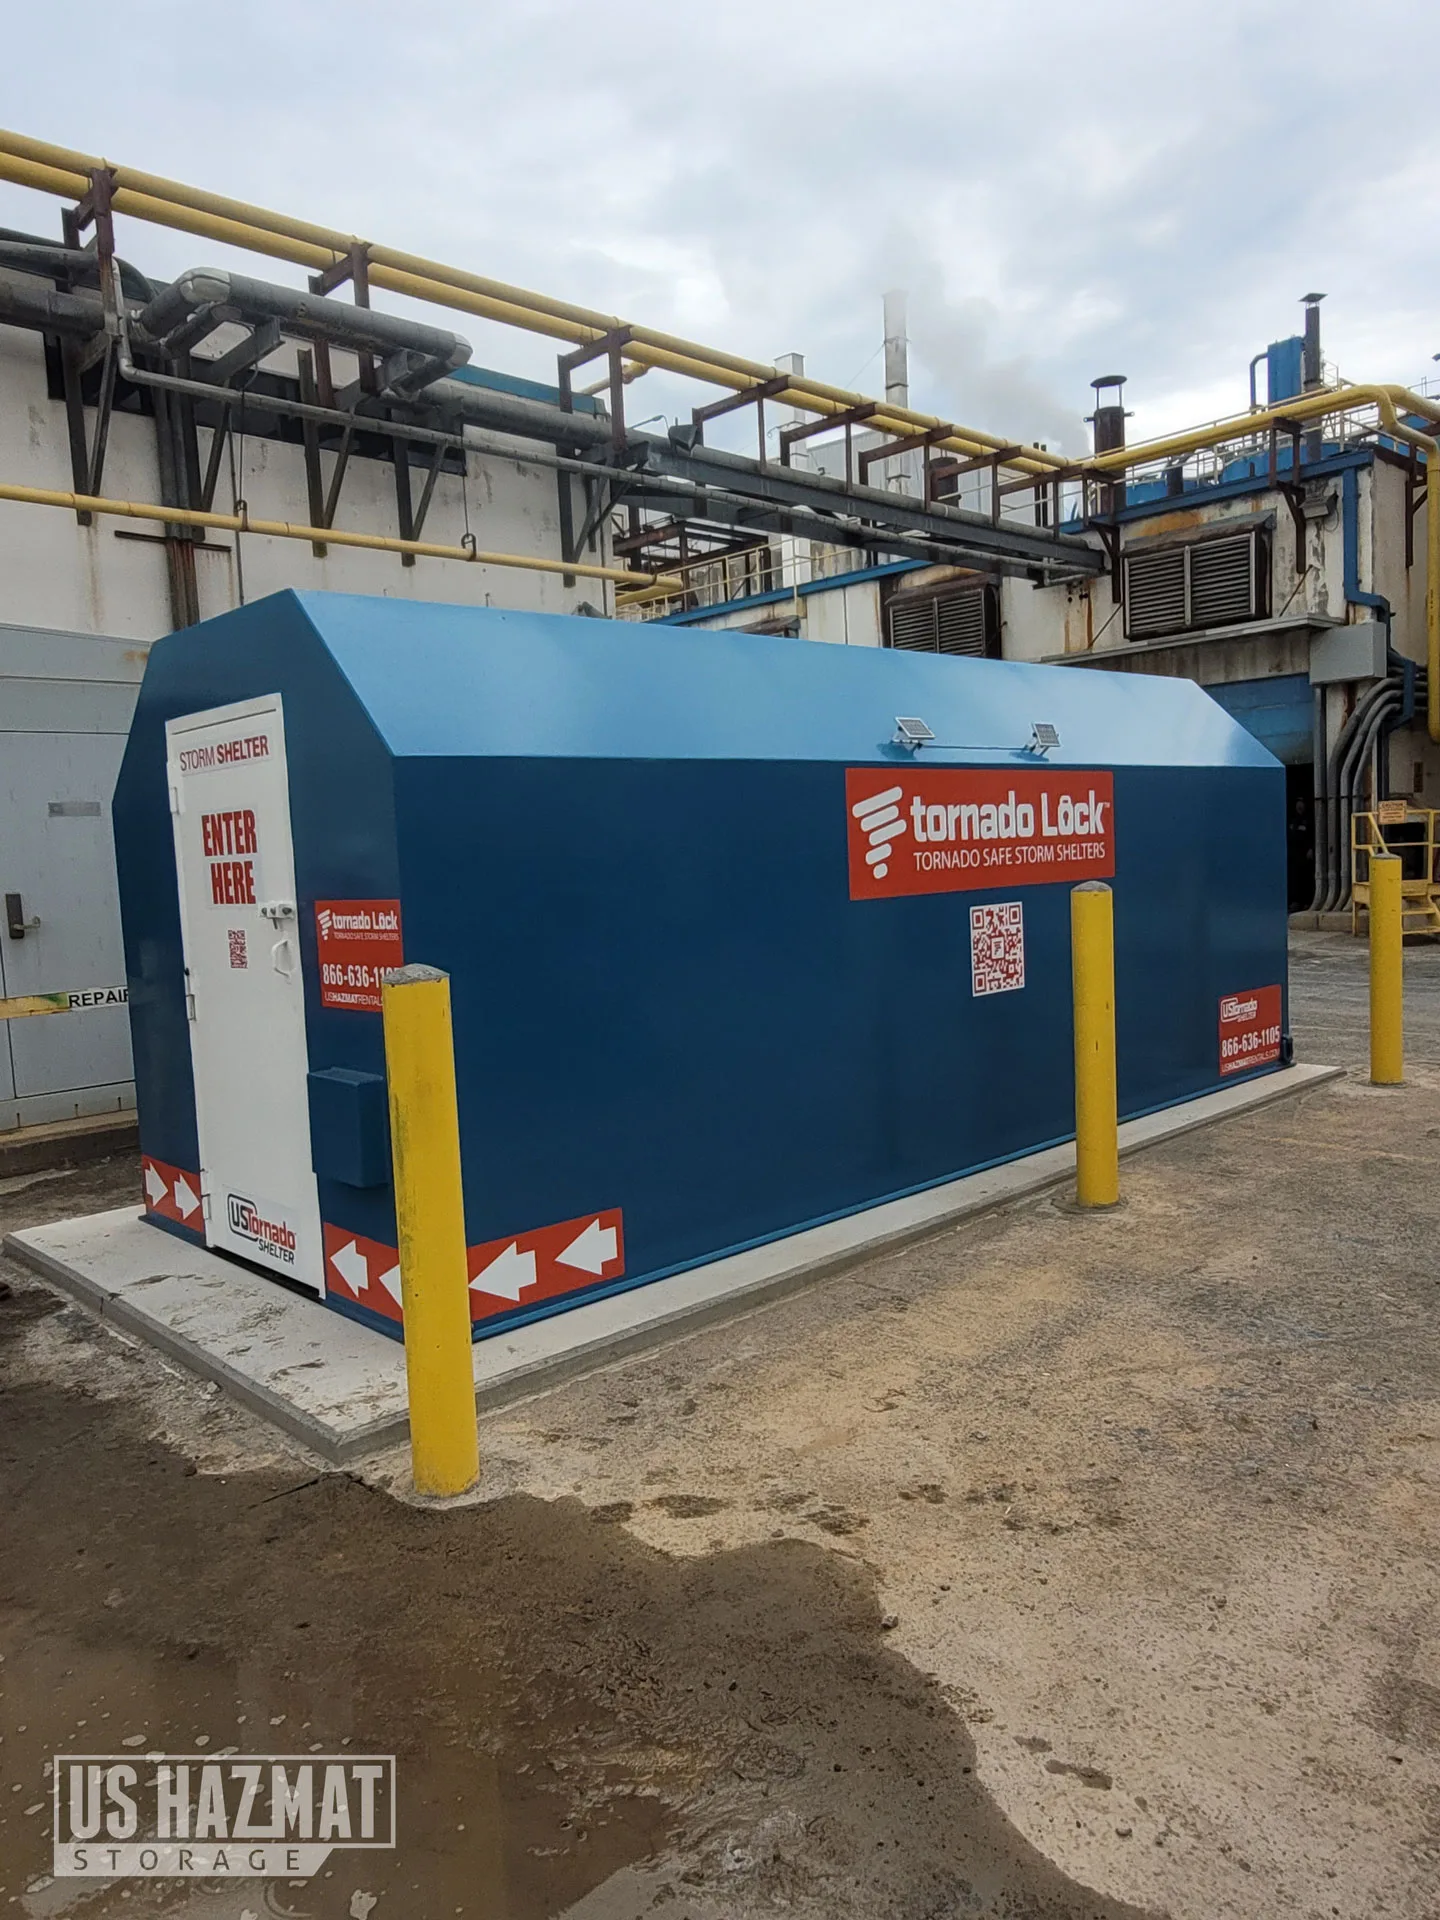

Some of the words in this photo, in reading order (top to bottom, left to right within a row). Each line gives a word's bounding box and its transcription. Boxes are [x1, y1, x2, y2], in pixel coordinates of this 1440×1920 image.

[180, 746, 216, 772] STORM
[216, 735, 269, 765] SHELTER
[201, 809, 257, 857] ENTER
[910, 791, 1034, 842] tornado
[913, 849, 980, 872] TORNADO
[983, 848, 1012, 867] SAFE
[1015, 845, 1055, 865] STORM
[1057, 841, 1105, 862] SHELTERS
[210, 860, 256, 905] HERE
[332, 910, 371, 930] tornado
[322, 963, 399, 988] 866-636-11
[1221, 1025, 1281, 1058] 866-636-1105
[258, 1238, 294, 1265] SHELTER
